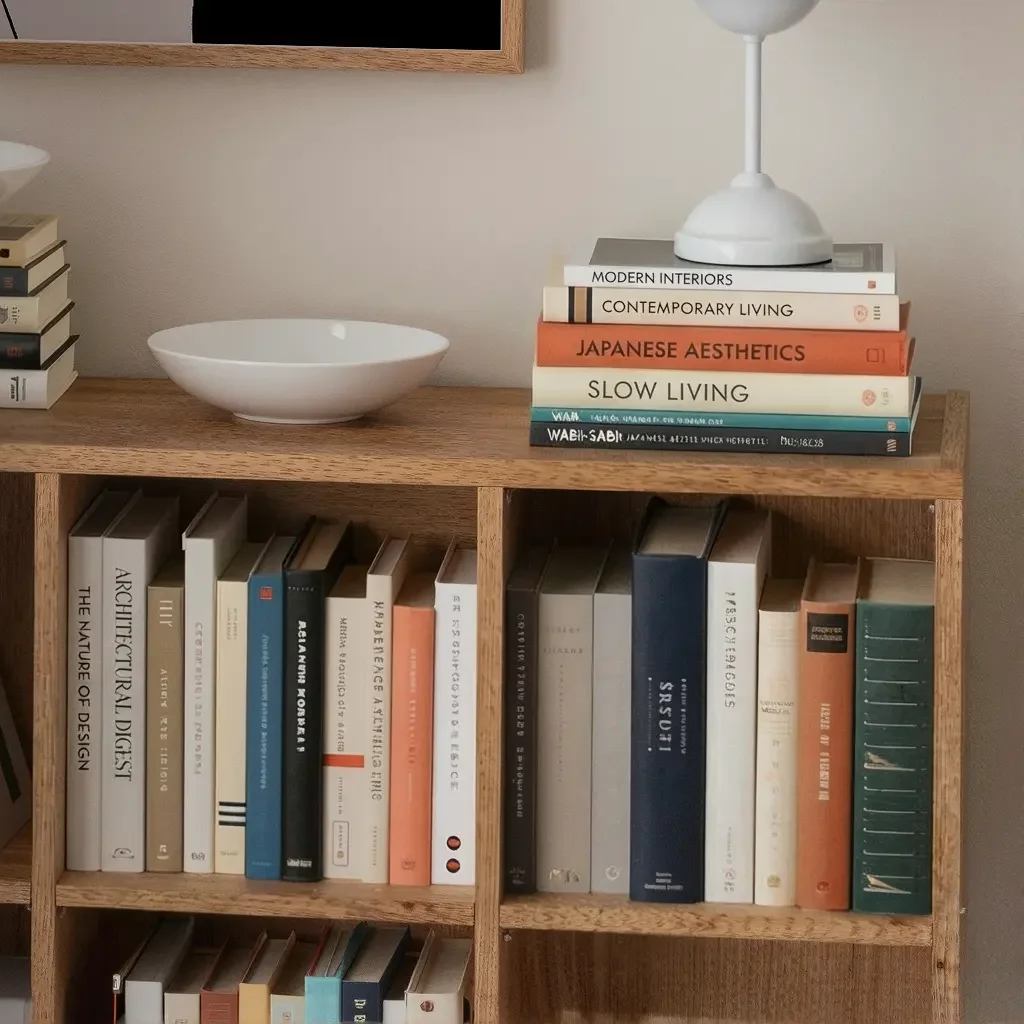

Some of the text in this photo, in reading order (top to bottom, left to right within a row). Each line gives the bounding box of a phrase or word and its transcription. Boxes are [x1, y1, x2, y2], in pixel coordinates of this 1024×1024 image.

[591, 271, 733, 286] MODERN INTERIORS
[602, 299, 794, 317] CONTEMPORARY LIVING
[575, 339, 806, 362] JAPANESE AESTHETICS
[588, 379, 749, 403] SLOW LIVING
[77, 586, 91, 771] THE NATURE OF DESIGN
[114, 568, 132, 782] ARCHITECTURAL DIGEST
